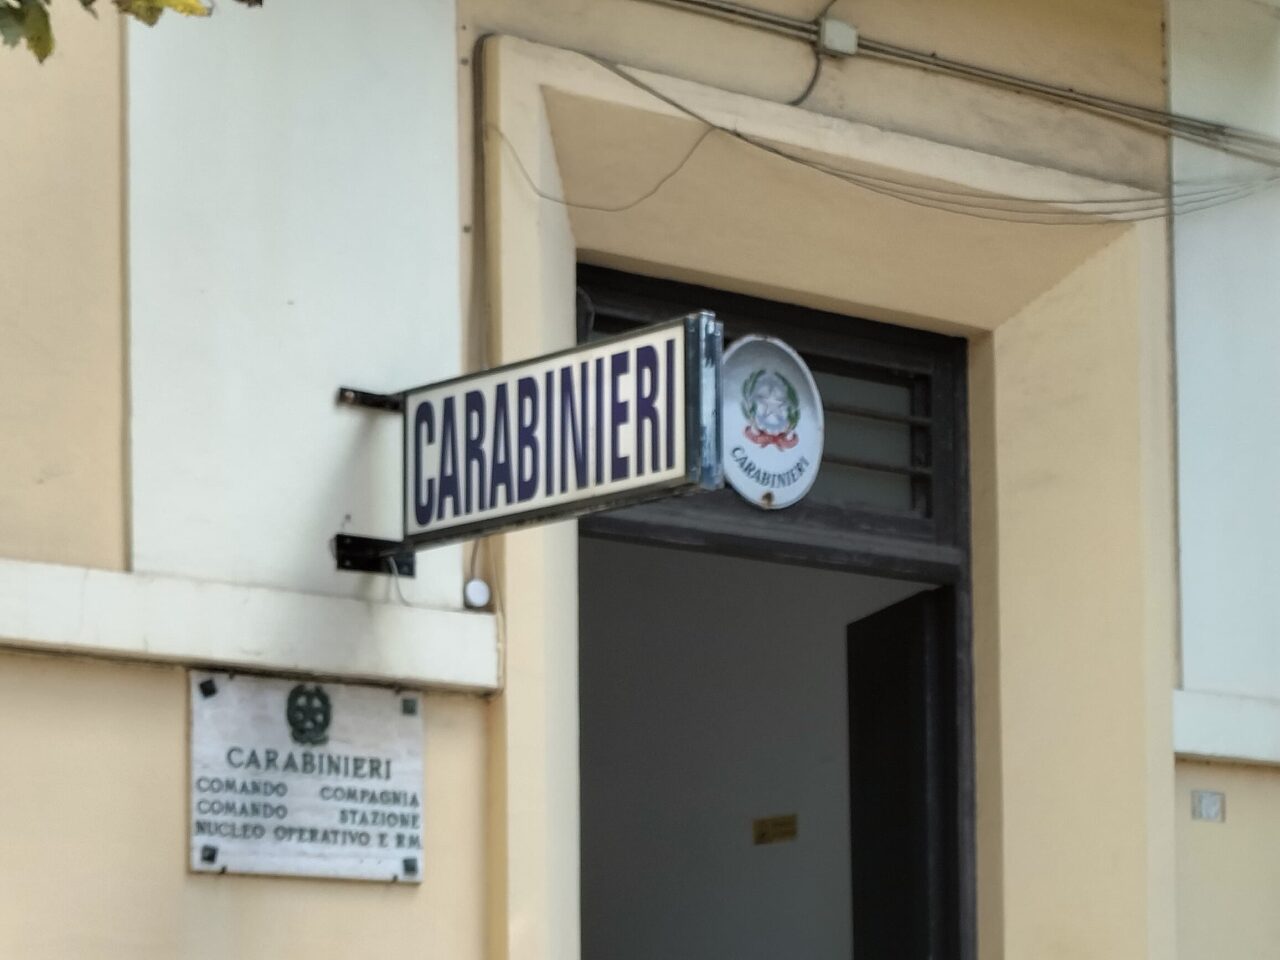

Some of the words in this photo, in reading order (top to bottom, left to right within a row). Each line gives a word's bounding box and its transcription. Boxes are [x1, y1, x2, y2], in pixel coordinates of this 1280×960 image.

[414, 339, 677, 528] CARABINIERI
[731, 446, 810, 488] CARABINIERI
[226, 746, 393, 780] CARABINIERI
[197, 777, 288, 797] COMANDO
[320, 785, 420, 807] COMPAGNIA
[197, 800, 288, 819] COMANDO
[340, 809, 421, 829] STAZIONE
[195, 821, 266, 839] NUCLEO
[273, 825, 371, 846] OPERATIVO
